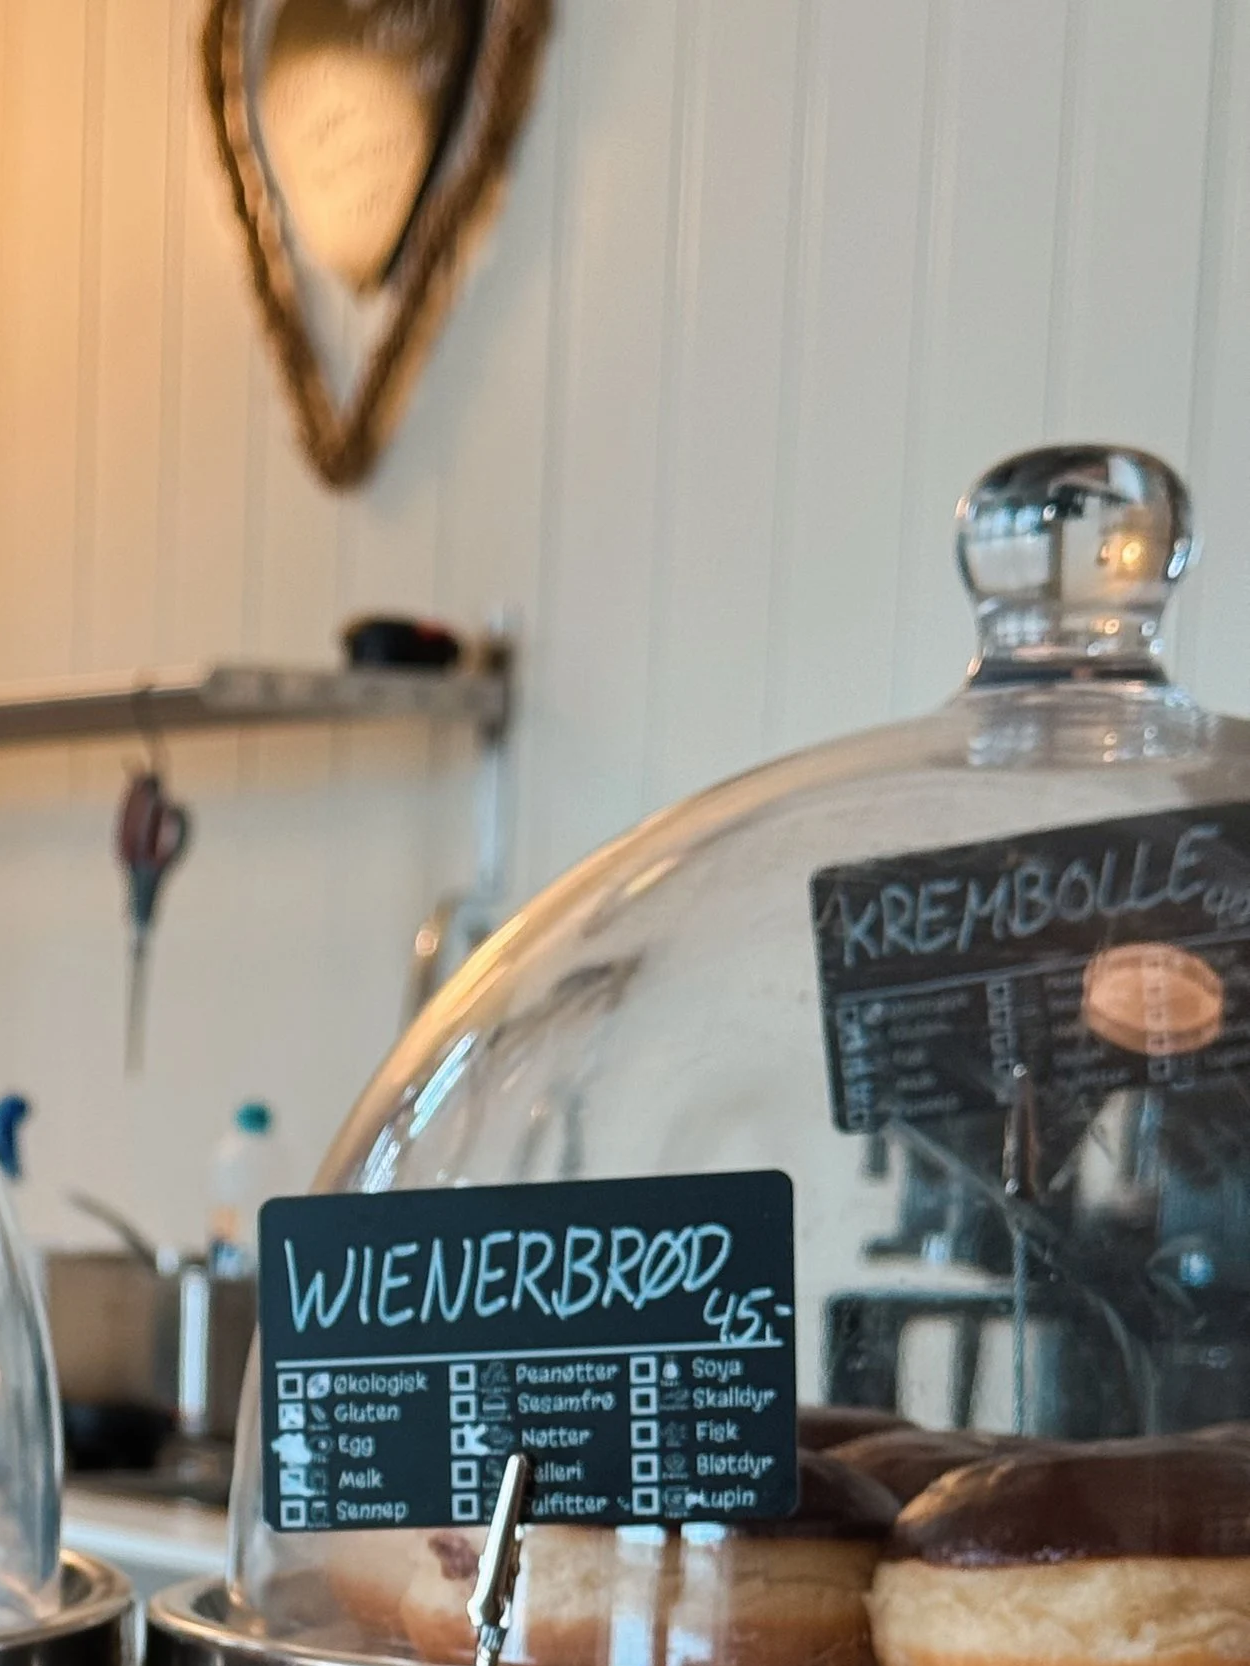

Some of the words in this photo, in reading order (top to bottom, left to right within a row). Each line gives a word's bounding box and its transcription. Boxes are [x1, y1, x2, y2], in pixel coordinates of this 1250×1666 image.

[818, 823, 1222, 967] KREMBOLLE
[284, 1222, 732, 1334] WIENERBRØD
[515, 1361, 620, 1384] Peanøtter
[691, 1357, 743, 1383] Soya
[333, 1371, 430, 1397] Økologisk
[517, 1389, 616, 1414] Sesamfrø
[692, 1386, 778, 1413] Skalldyr
[333, 1401, 401, 1423] Gluten
[521, 1426, 592, 1448] Nøtter
[695, 1419, 741, 1443] Fisk
[338, 1433, 376, 1458] Egg
[534, 1460, 585, 1482] elleri
[696, 1452, 775, 1479] Bløtdyr
[338, 1468, 385, 1490] Melk
[336, 1500, 410, 1523] Sennep
[530, 1493, 609, 1515] ulfitter
[702, 1488, 756, 1512] Lupin
